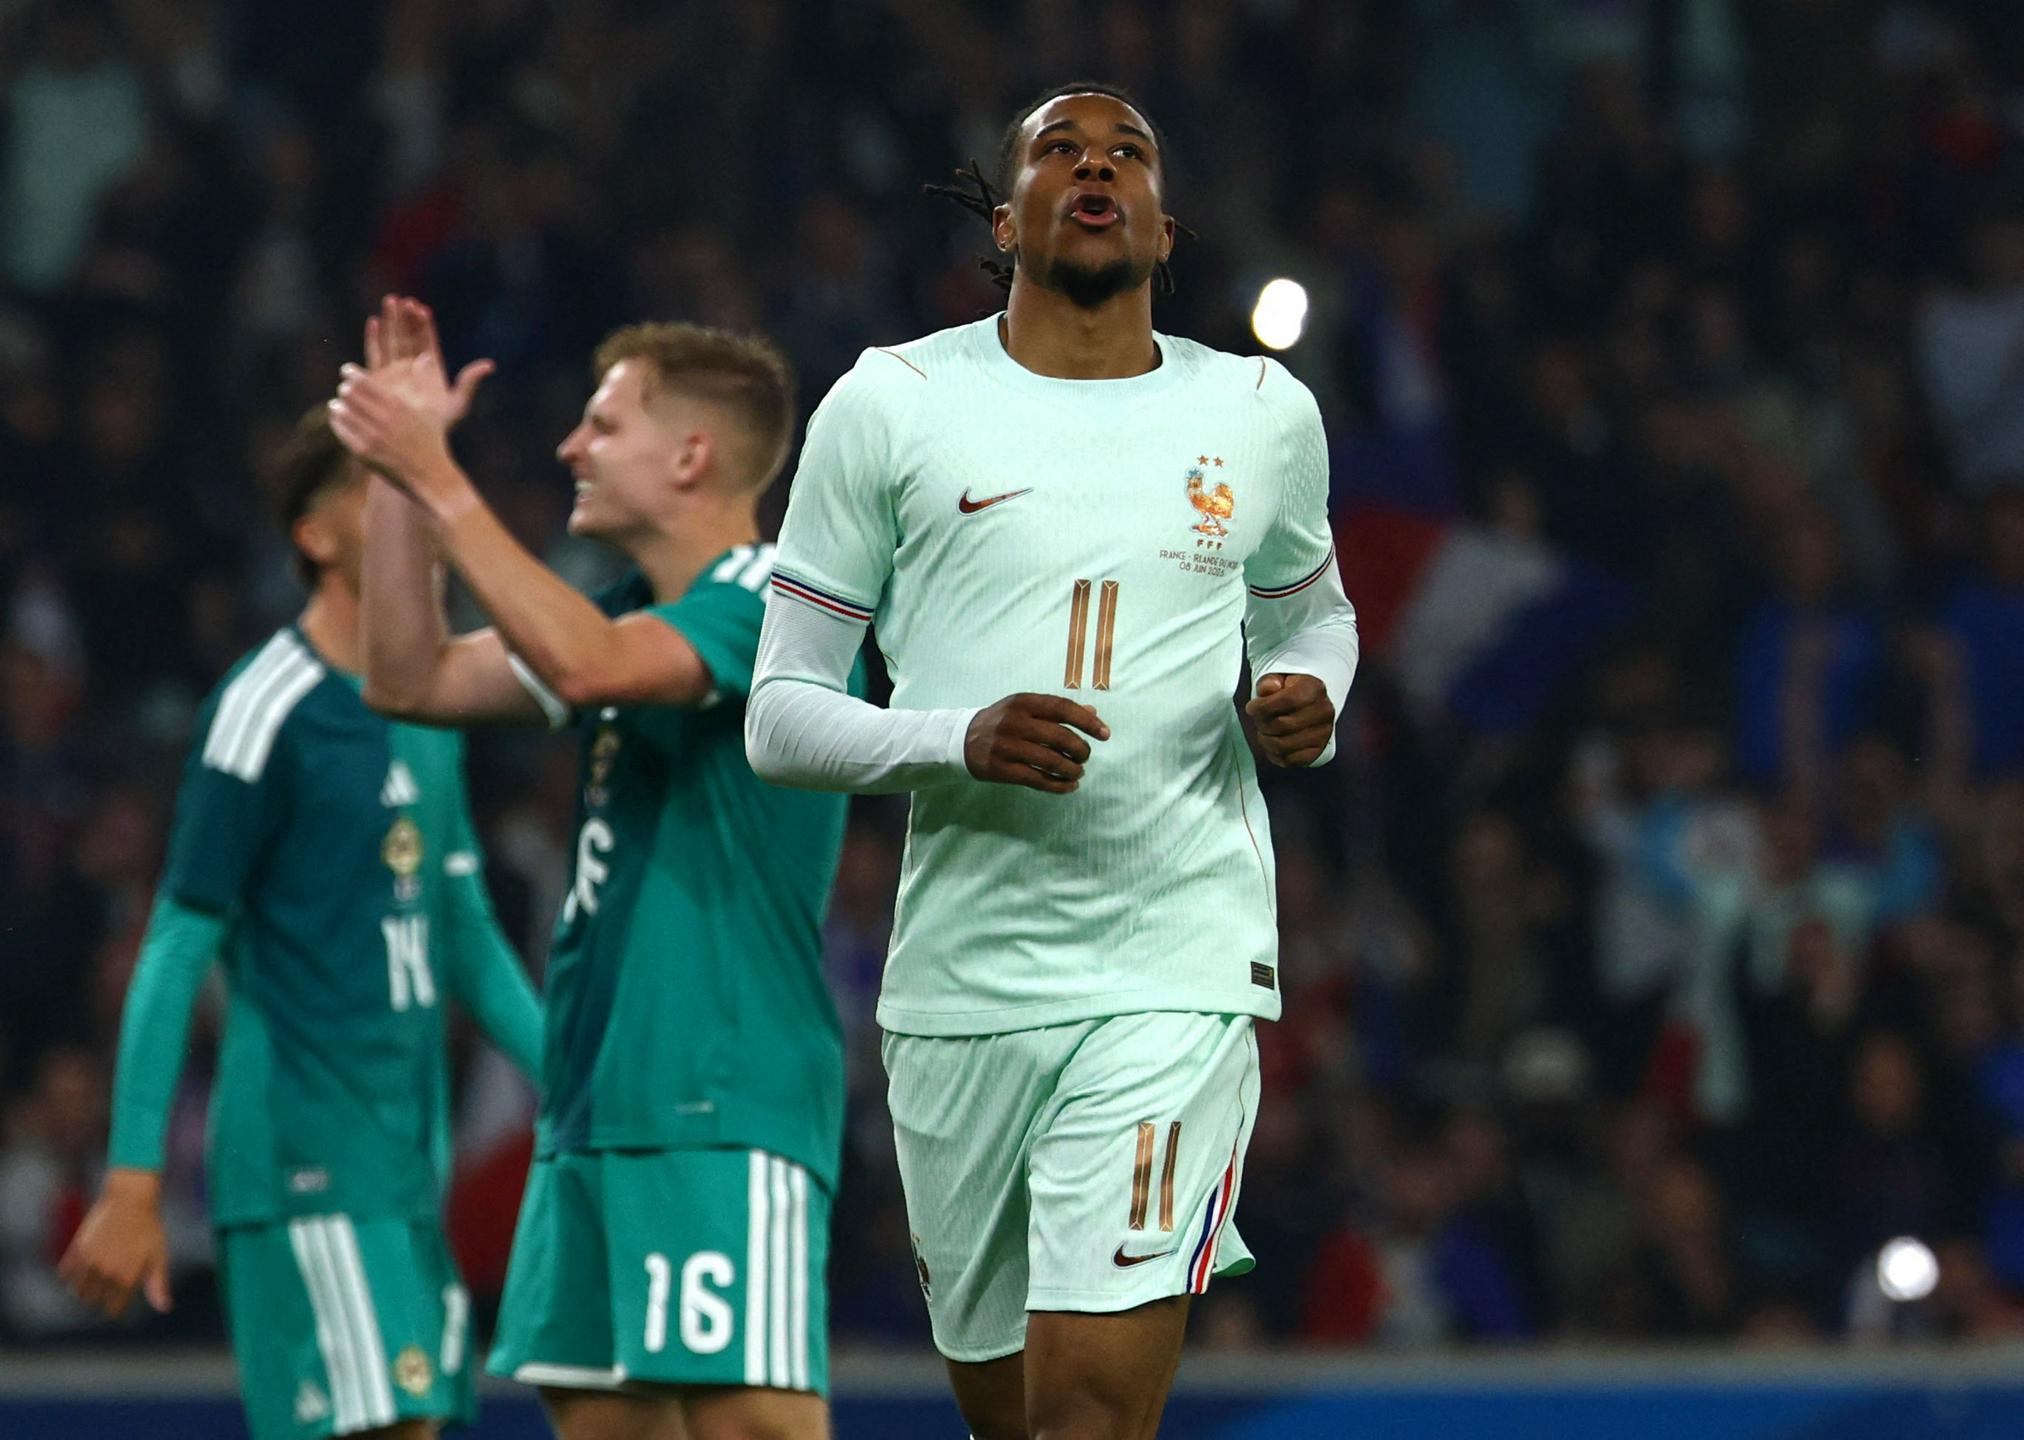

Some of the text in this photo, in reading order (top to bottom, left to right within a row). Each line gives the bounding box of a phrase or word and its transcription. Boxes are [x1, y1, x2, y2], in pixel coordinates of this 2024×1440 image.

[1160, 550, 1186, 560] FRANCE
[1179, 562, 1191, 571] 08
[1064, 579, 1119, 690] 11
[1128, 1121, 1182, 1232] 11
[644, 1250, 735, 1354] 16
